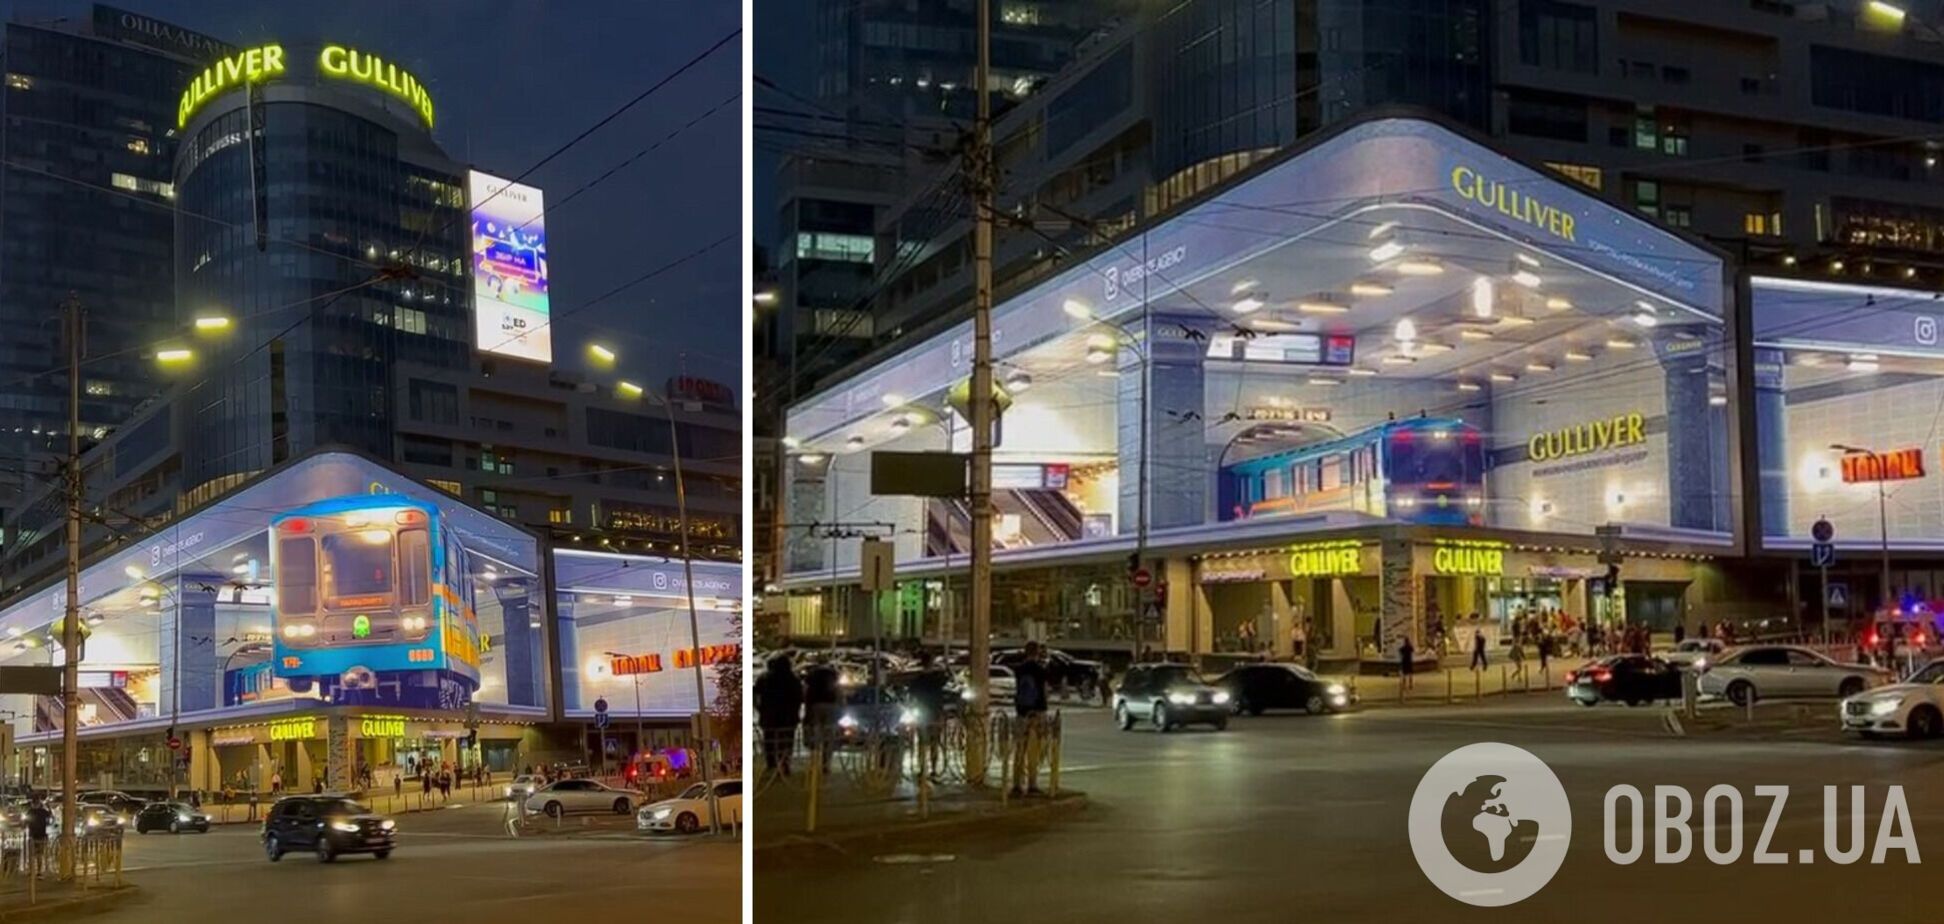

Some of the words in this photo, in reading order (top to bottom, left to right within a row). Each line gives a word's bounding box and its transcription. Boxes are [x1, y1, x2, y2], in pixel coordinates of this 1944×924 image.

[178, 44, 284, 127] GULLIVER
[1452, 166, 1575, 242] GULLIVER
[1529, 412, 1646, 462] GULLIVER
[1290, 549, 1360, 576] GULLIVER
[1435, 548, 1504, 574] GULLIVER
[270, 722, 315, 740] GULLIVER
[362, 719, 406, 737] GULLIVER
